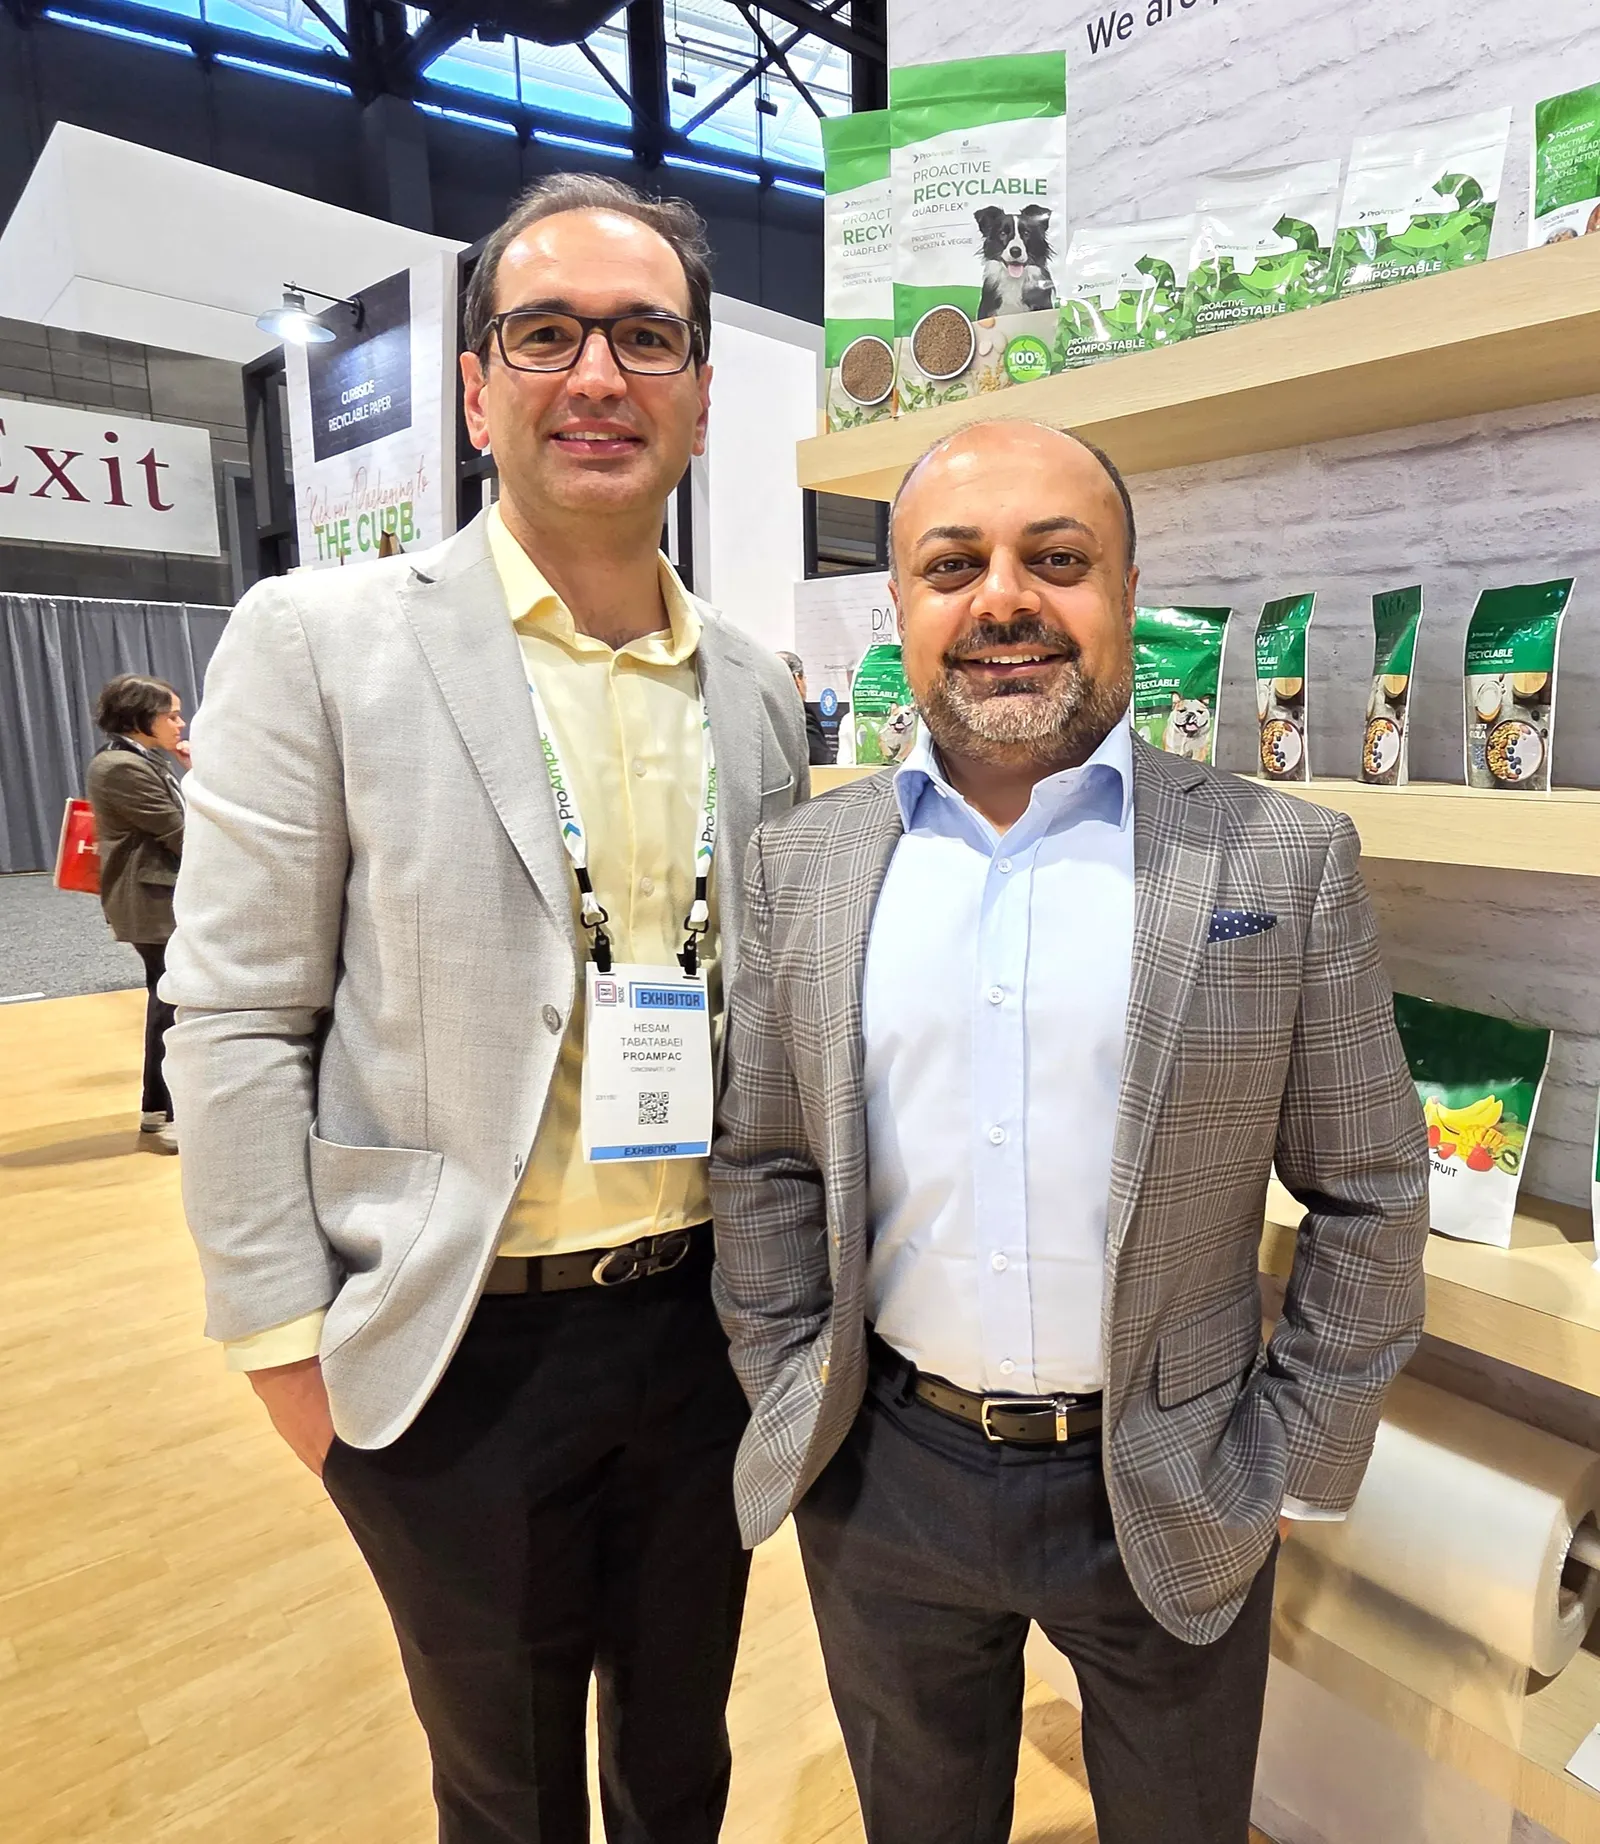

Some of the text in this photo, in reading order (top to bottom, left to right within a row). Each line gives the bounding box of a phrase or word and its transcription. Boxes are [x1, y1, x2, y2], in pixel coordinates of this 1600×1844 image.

[1086, 10, 1134, 55] We
[1574, 149, 1600, 164] RETOR
[913, 160, 992, 184] PROACTIVE
[913, 178, 1048, 205] RECYCLABLE
[911, 231, 947, 243] PROBIOTIC
[912, 240, 941, 252] CHICKEN
[947, 237, 973, 246] VEGGIE
[1341, 261, 1442, 287] CMPOSTABLE
[1196, 303, 1287, 323] COMPOSTABLE
[1198, 298, 1247, 312] PROACTIVE
[1066, 338, 1145, 356] COMPOSTABLE
[1009, 351, 1046, 365] 100%
[341, 379, 376, 405] CURBSIDE
[328, 395, 392, 432] RECYCLABLE PAPER
[314, 518, 352, 562] THE
[1468, 648, 1514, 660] RECYCLABLE
[640, 991, 701, 1008] EXHIBITOR
[633, 1023, 671, 1033] HESAM
[620, 1037, 683, 1047] TABATABAEI
[622, 1051, 682, 1062] PROAMPAC
[624, 1144, 677, 1157] EXHIBITOR
